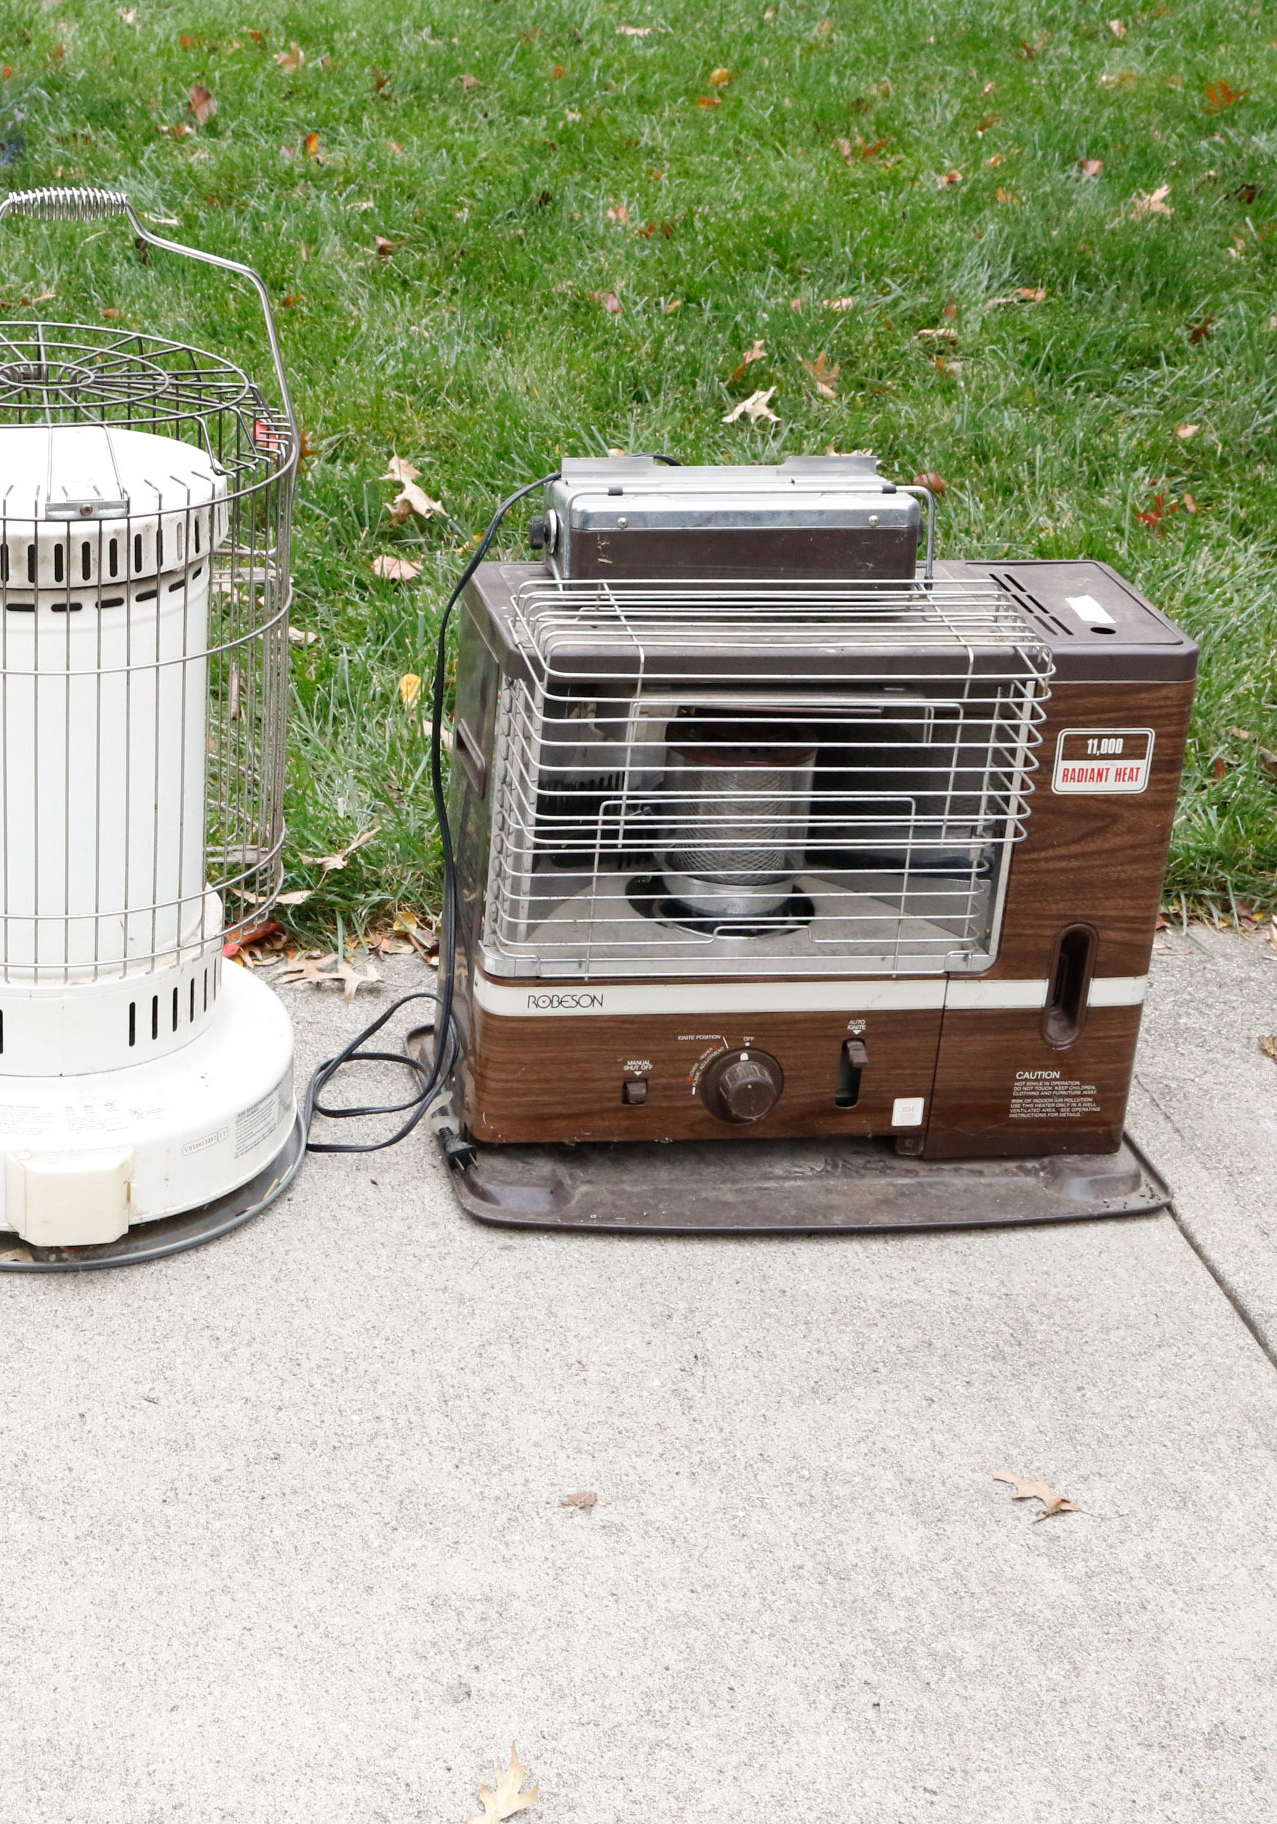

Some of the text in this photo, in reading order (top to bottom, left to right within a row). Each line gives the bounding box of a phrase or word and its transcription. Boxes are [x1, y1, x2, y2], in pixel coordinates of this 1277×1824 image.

[1087, 738, 1124, 756] 11,000
[1061, 766, 1142, 783] RADIANT HEAT
[527, 994, 604, 1009] ROBESON
[1015, 1071, 1061, 1080] CAUTION
